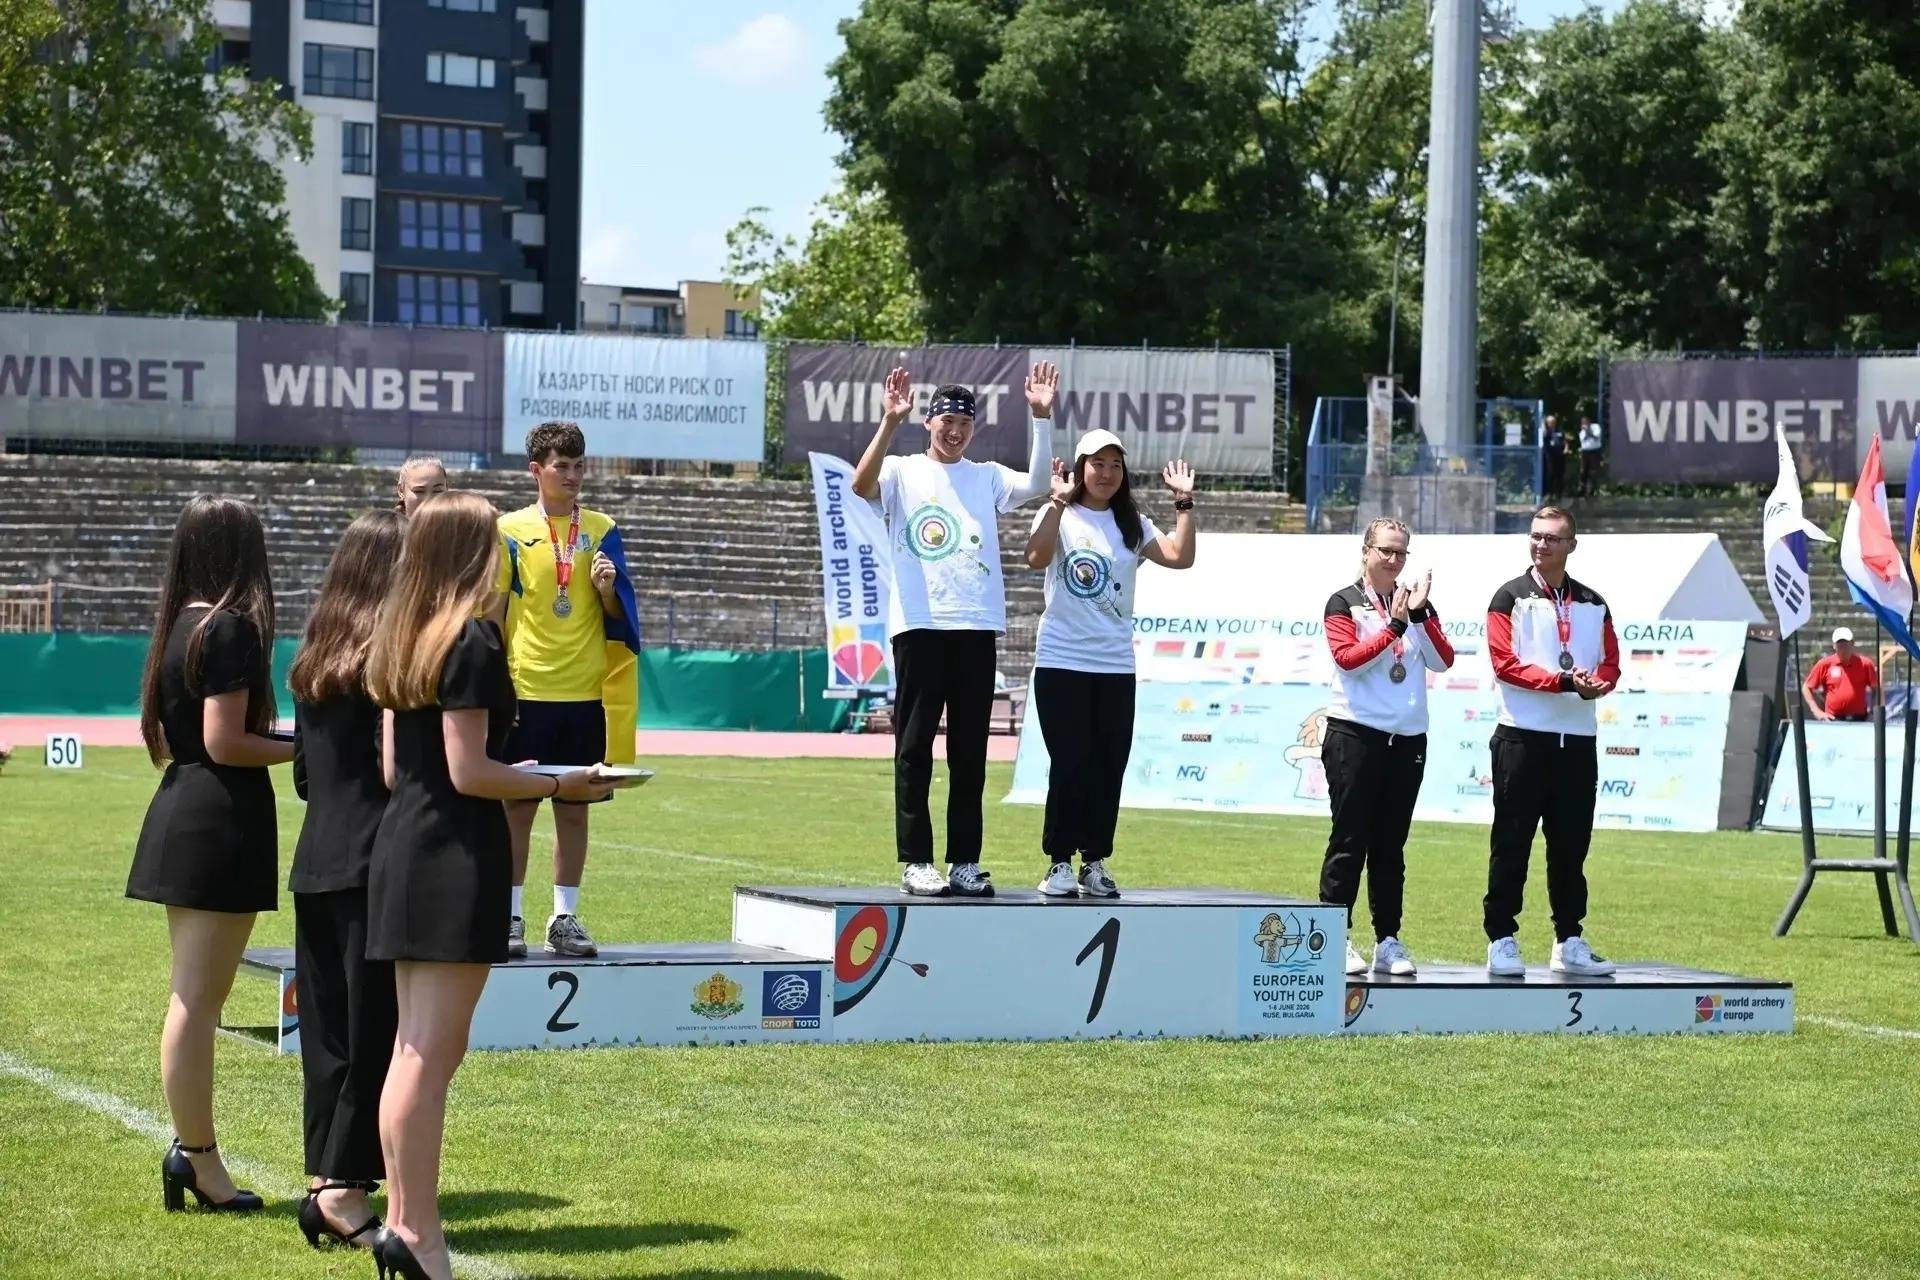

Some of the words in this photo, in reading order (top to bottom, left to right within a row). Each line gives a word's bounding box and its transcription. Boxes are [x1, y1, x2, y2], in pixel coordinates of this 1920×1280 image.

[0, 354, 205, 401] WINBET
[262, 362, 475, 413] WINBET
[537, 371, 619, 394] ХАЗАРТЪТ
[624, 375, 666, 395] НОСИ
[669, 376, 709, 396] РИСК
[714, 378, 735, 397] ОТ
[520, 397, 611, 421] РАЗВИВАНЕ
[617, 401, 638, 421] НА
[643, 402, 748, 425] ЗАВИСИМОСТ
[1053, 390, 1256, 435] WINBET
[1623, 399, 1843, 443] WINBET
[823, 468, 848, 551] archery
[831, 557, 853, 620] world
[858, 543, 880, 618] europe
[1132, 616, 1209, 634] ROPEAN
[1216, 618, 1283, 636] YOUTH
[1290, 620, 1323, 637] CU
[1623, 623, 1695, 642] GARIA
[52, 737, 78, 765] 50
[1075, 917, 1121, 1025] 1
[1253, 974, 1324, 986] EUROPEAN
[546, 970, 580, 1033] 2
[1253, 990, 1295, 1002] YOUTH
[1298, 990, 1324, 1002] CUP
[1565, 991, 1583, 1027] 3
[1723, 996, 1750, 1007] world
[1751, 996, 1785, 1009] archery
[762, 1019, 794, 1028] СПОРТ
[795, 1019, 819, 1028] ТОТО
[1262, 1011, 1281, 1019] RUSE,
[1723, 1010, 1754, 1021] europe
